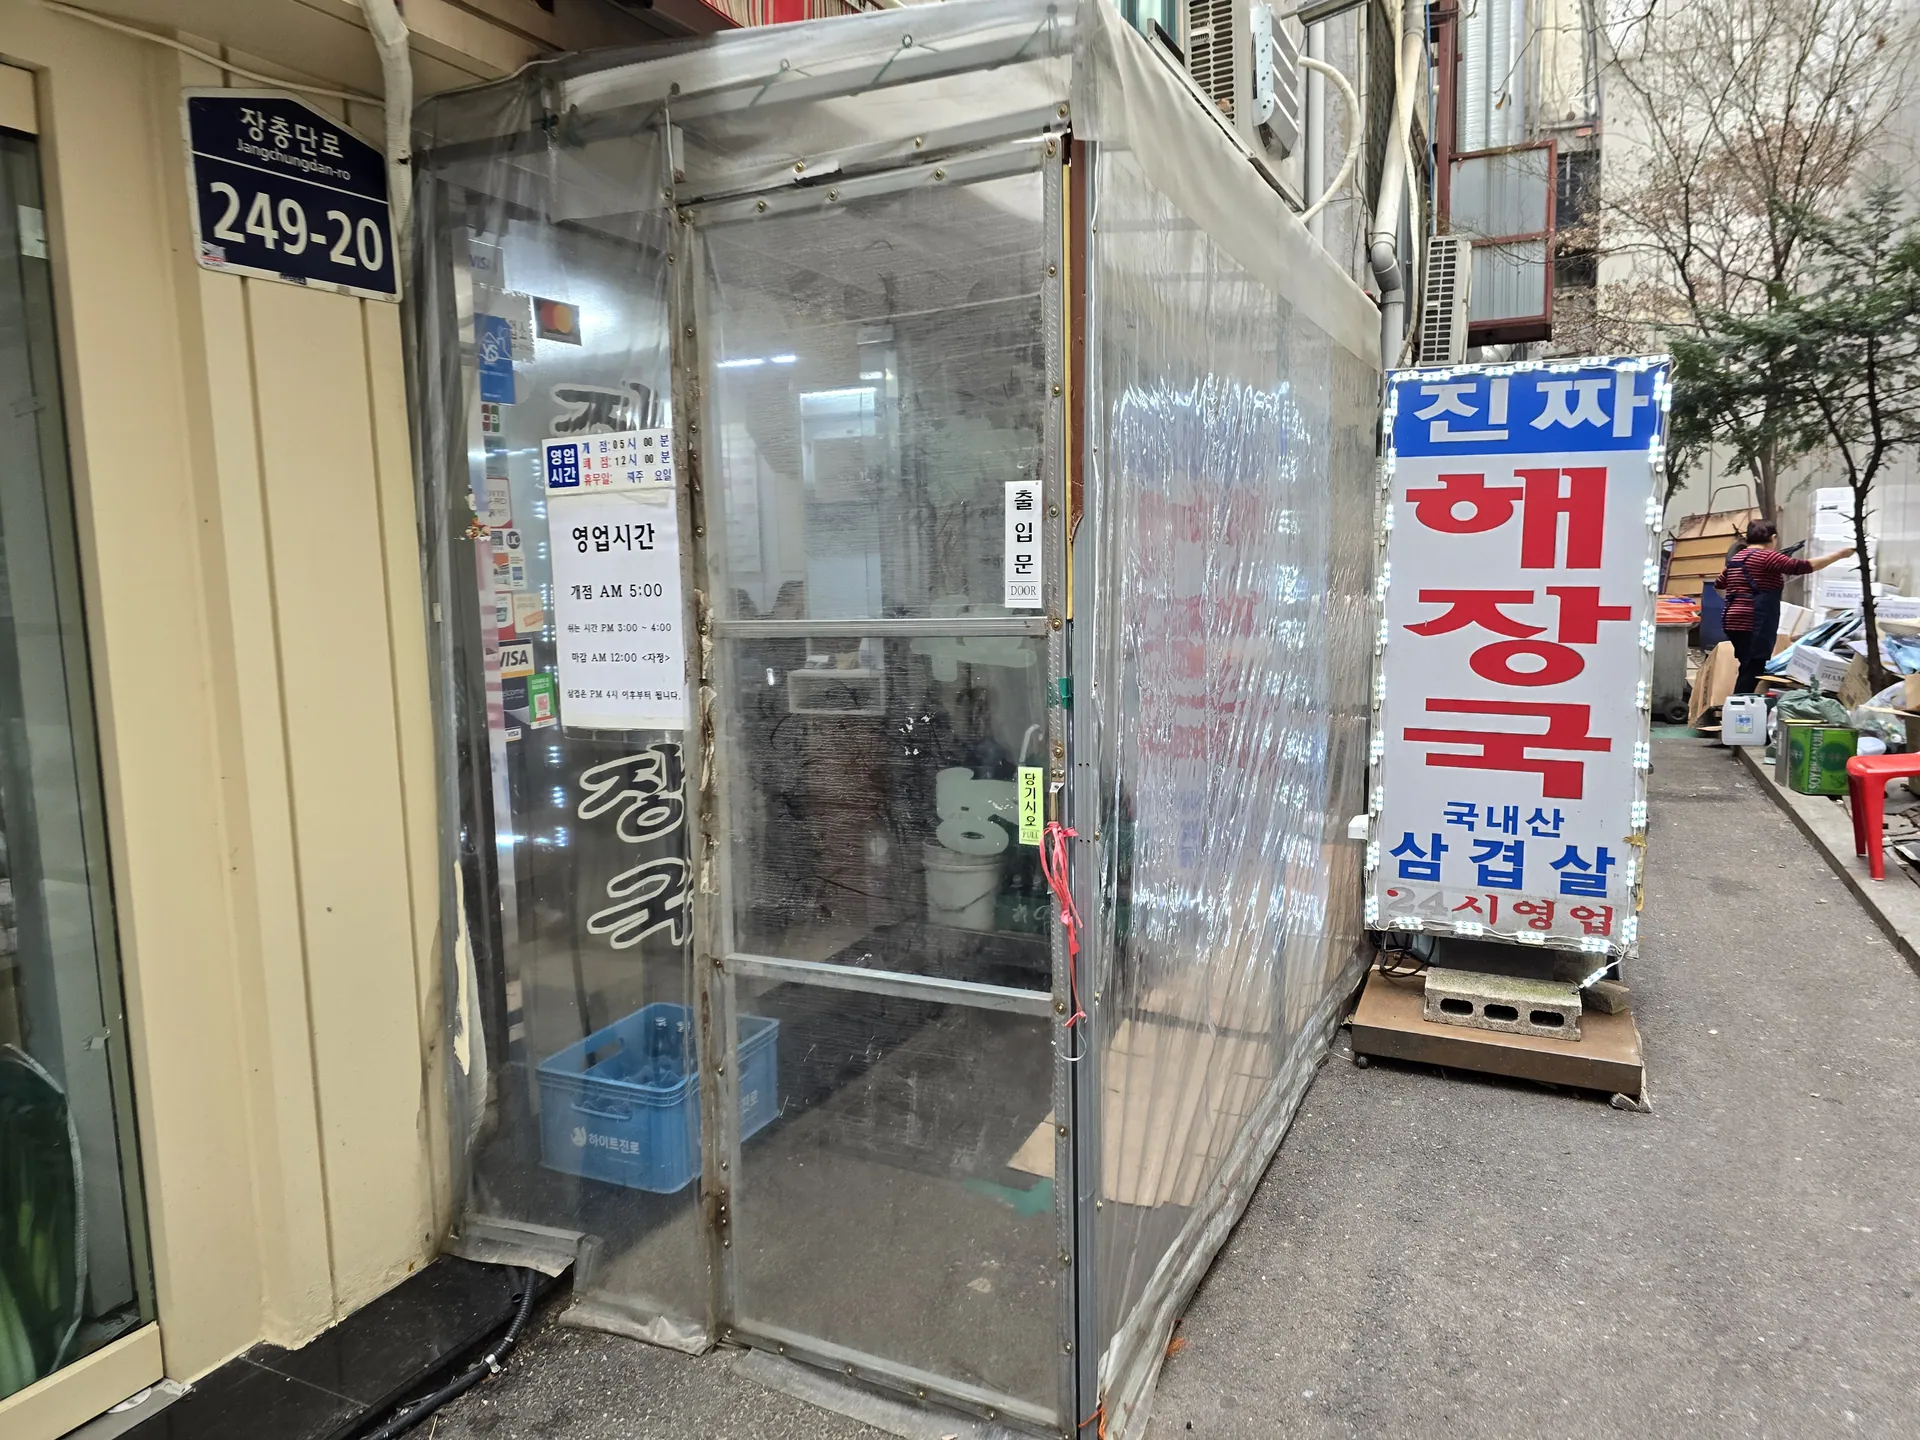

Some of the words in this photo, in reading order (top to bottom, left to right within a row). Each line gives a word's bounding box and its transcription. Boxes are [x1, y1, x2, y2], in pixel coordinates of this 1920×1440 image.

[239, 107, 344, 159] 장충단로
[236, 138, 350, 181] Jangchungdan-ro
[209, 181, 384, 272] 249-20
[1413, 371, 1650, 443] 진짜
[550, 448, 575, 465] 영업
[551, 467, 576, 483] 시간
[654, 468, 672, 481] 요일
[572, 523, 655, 553] 영업시간
[1014, 489, 1034, 574] 출입문
[570, 584, 593, 600] 개점
[600, 584, 623, 598] AM
[629, 583, 663, 598] 5:00
[1010, 585, 1037, 596] DOOR
[584, 623, 598, 633] 시간
[601, 623, 614, 632] PM
[617, 623, 638, 632] 3:00
[650, 623, 672, 632] 4:00
[1402, 466, 1632, 800] 해장국
[571, 652, 587, 663] 마감
[591, 652, 607, 662] AM
[610, 652, 637, 662] 12:00
[641, 652, 671, 664] <자정>
[590, 690, 603, 699] PM
[606, 690, 618, 699] 4시
[621, 690, 651, 700] 이후부터
[1024, 772, 1037, 827] 당기시오
[1443, 801, 1565, 839] 국내산
[1389, 831, 1616, 898] 삼겹살
[588, 1132, 640, 1156] 하이트진로
